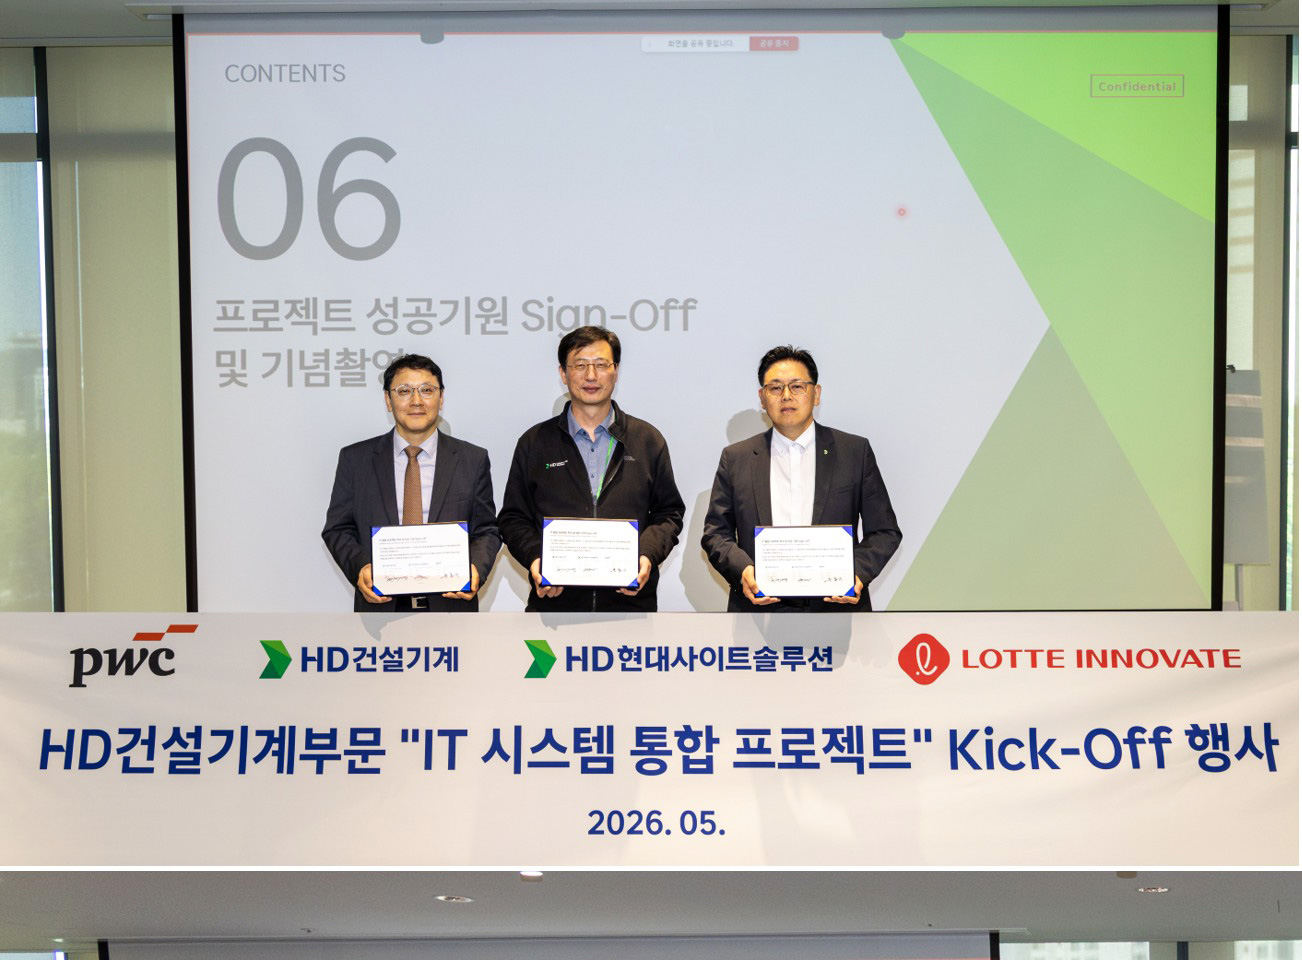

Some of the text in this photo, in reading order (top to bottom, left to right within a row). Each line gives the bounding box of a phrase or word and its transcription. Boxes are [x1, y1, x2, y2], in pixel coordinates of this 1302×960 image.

[225, 64, 345, 82] CONTENTS
[1098, 82, 1176, 92] Confidential
[218, 137, 400, 261] 06
[213, 296, 699, 338] 프로젝트 성공기원 Sign-Off
[216, 349, 248, 387] 및
[69, 646, 175, 687] pwc
[301, 647, 458, 672] HD건설기계
[566, 645, 833, 671] HD현대사이트솔루션
[963, 649, 1241, 669] LOTTE INNOVATE
[40, 725, 385, 774] HD건설기계부문
[481, 725, 613, 774] 시스템
[630, 725, 720, 776] 통합
[950, 726, 1172, 771] Kick-Off
[1185, 723, 1279, 773] 행사
